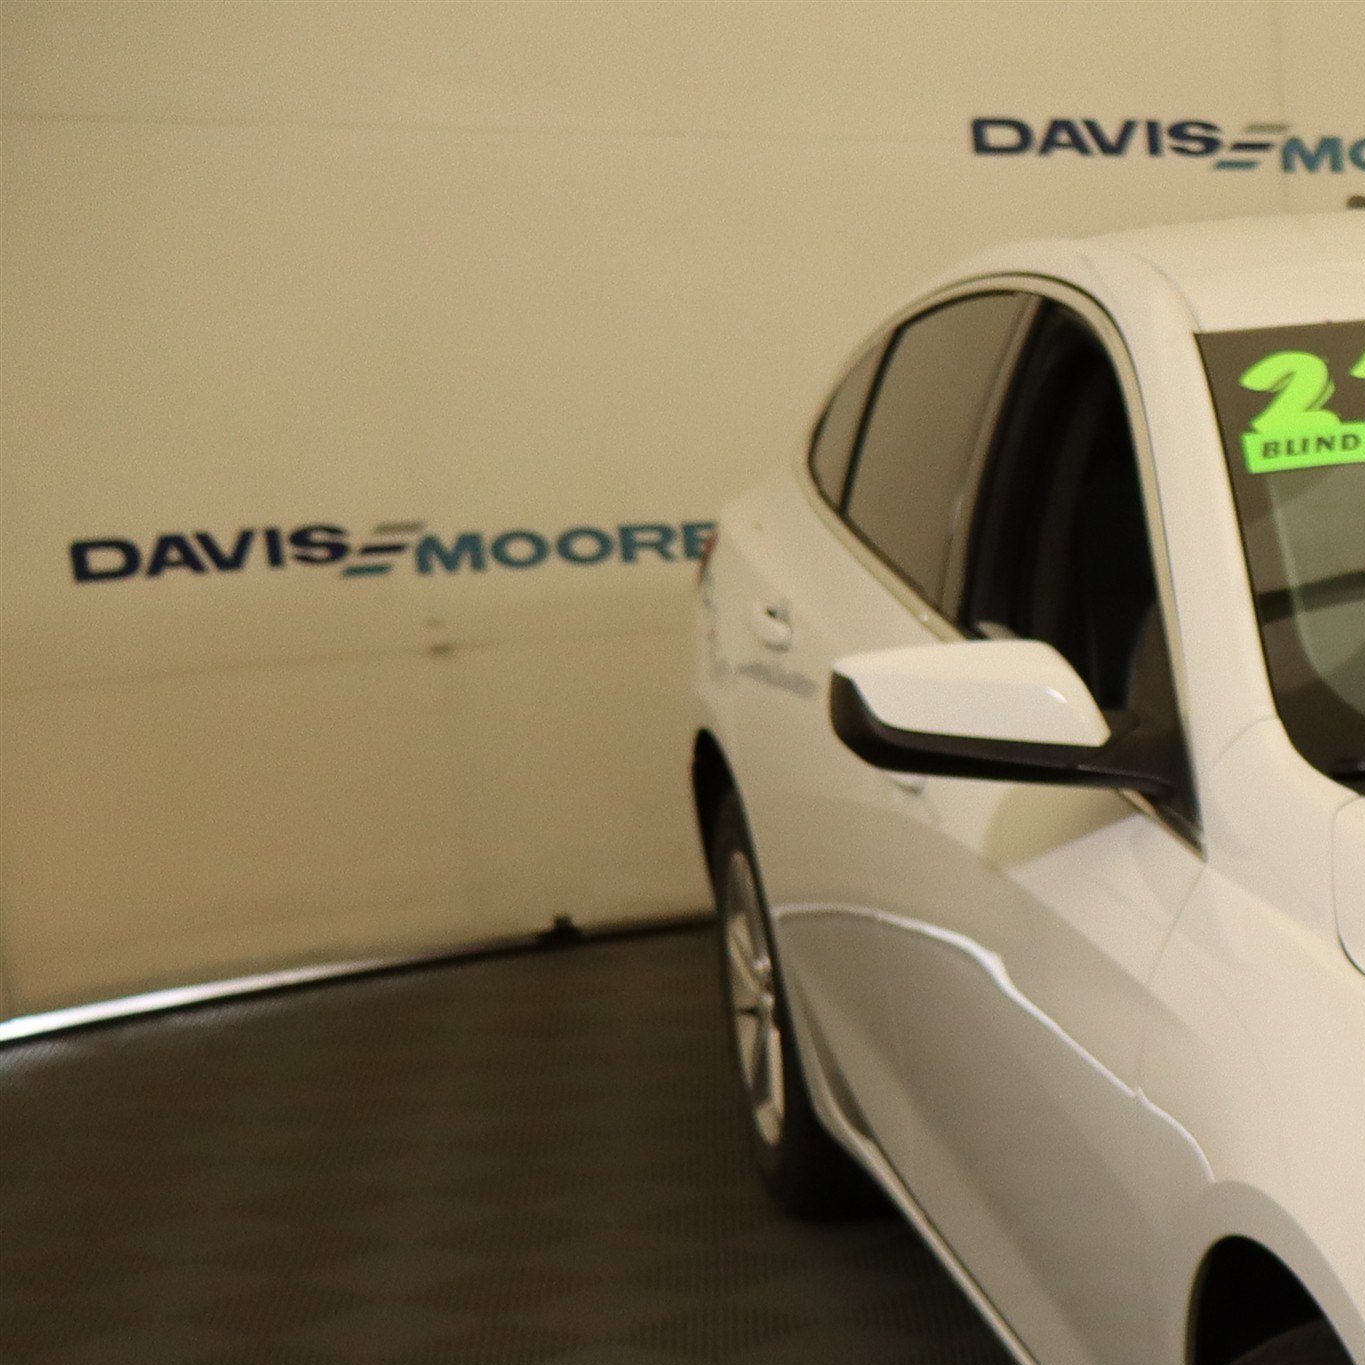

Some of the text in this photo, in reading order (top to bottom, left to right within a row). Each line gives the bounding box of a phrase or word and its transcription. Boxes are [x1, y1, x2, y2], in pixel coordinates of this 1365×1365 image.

[971, 117, 1222, 156] DAVIS
[1261, 433, 1362, 460] BLIND
[70, 525, 350, 583] DAVIS
